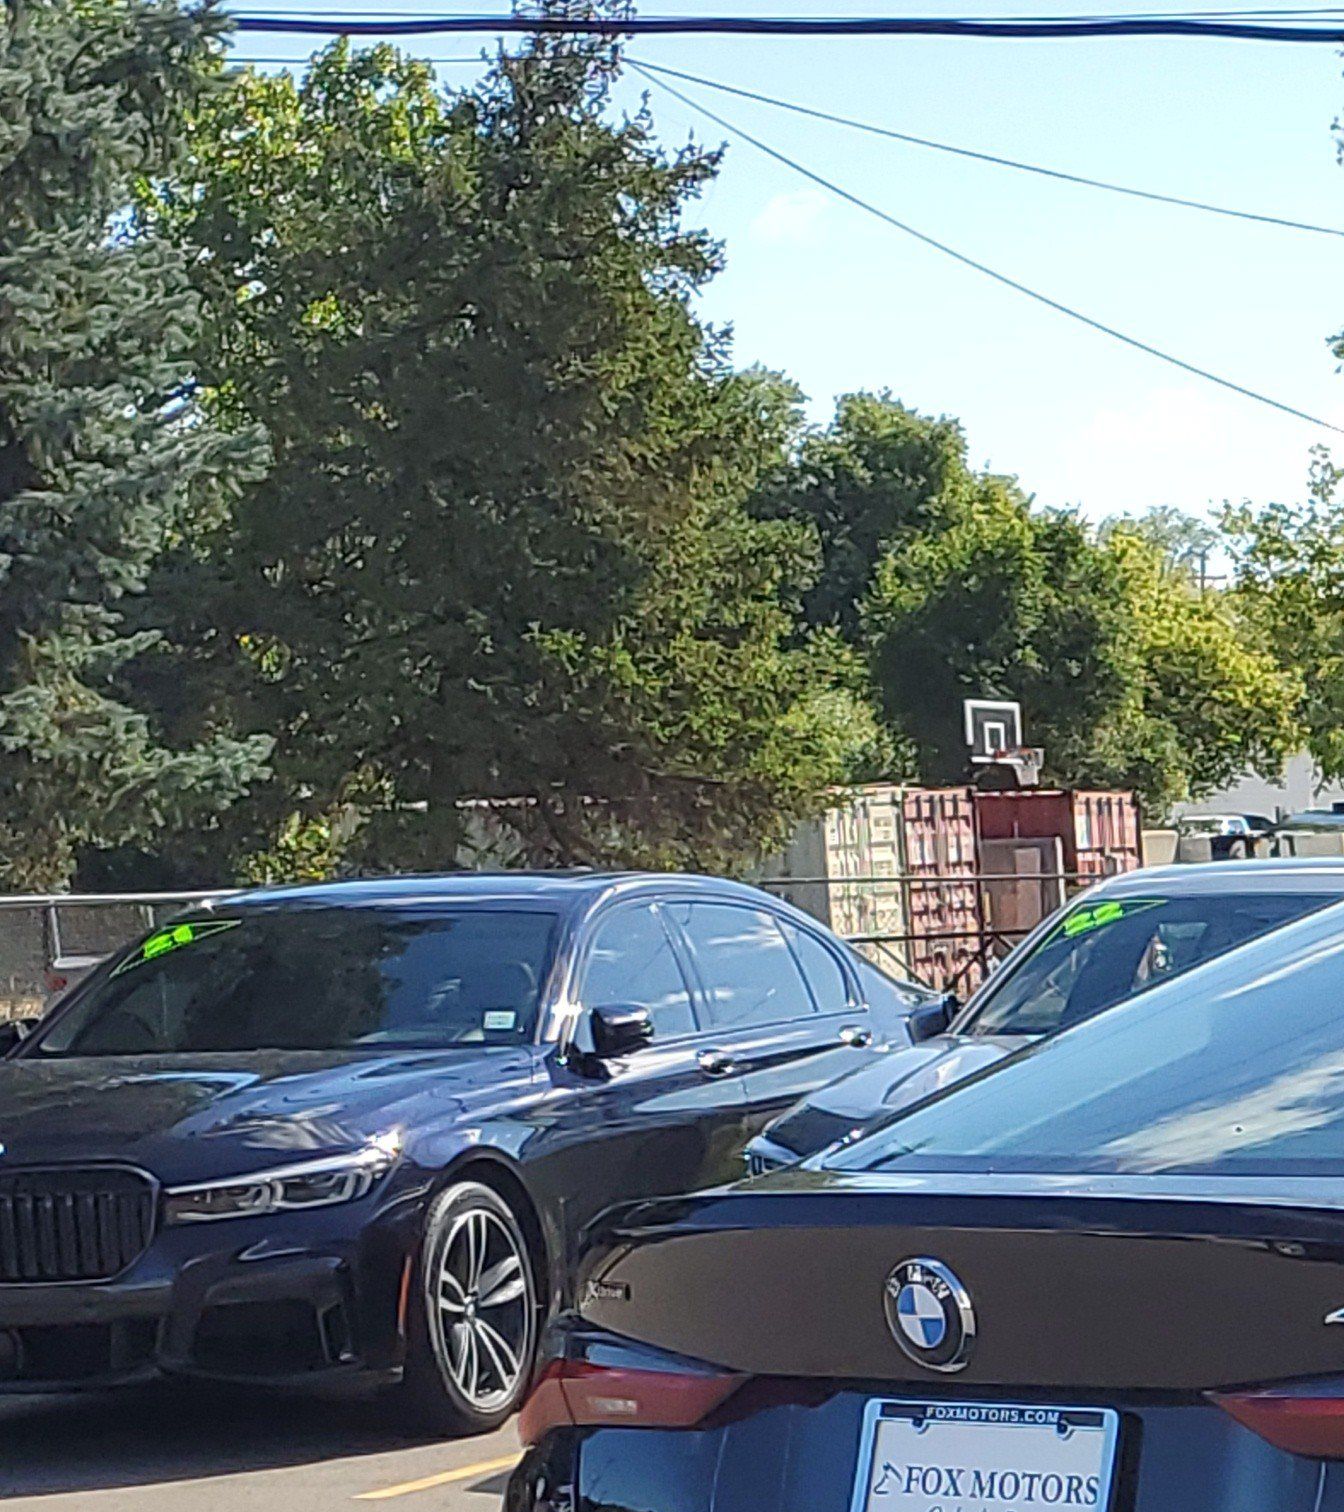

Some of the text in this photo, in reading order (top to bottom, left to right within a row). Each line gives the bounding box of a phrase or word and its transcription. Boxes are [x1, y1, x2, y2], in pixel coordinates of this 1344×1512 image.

[925, 1406, 1060, 1424] FOXMOTORS.COM
[904, 1465, 1100, 1506] FOX MOTORS
